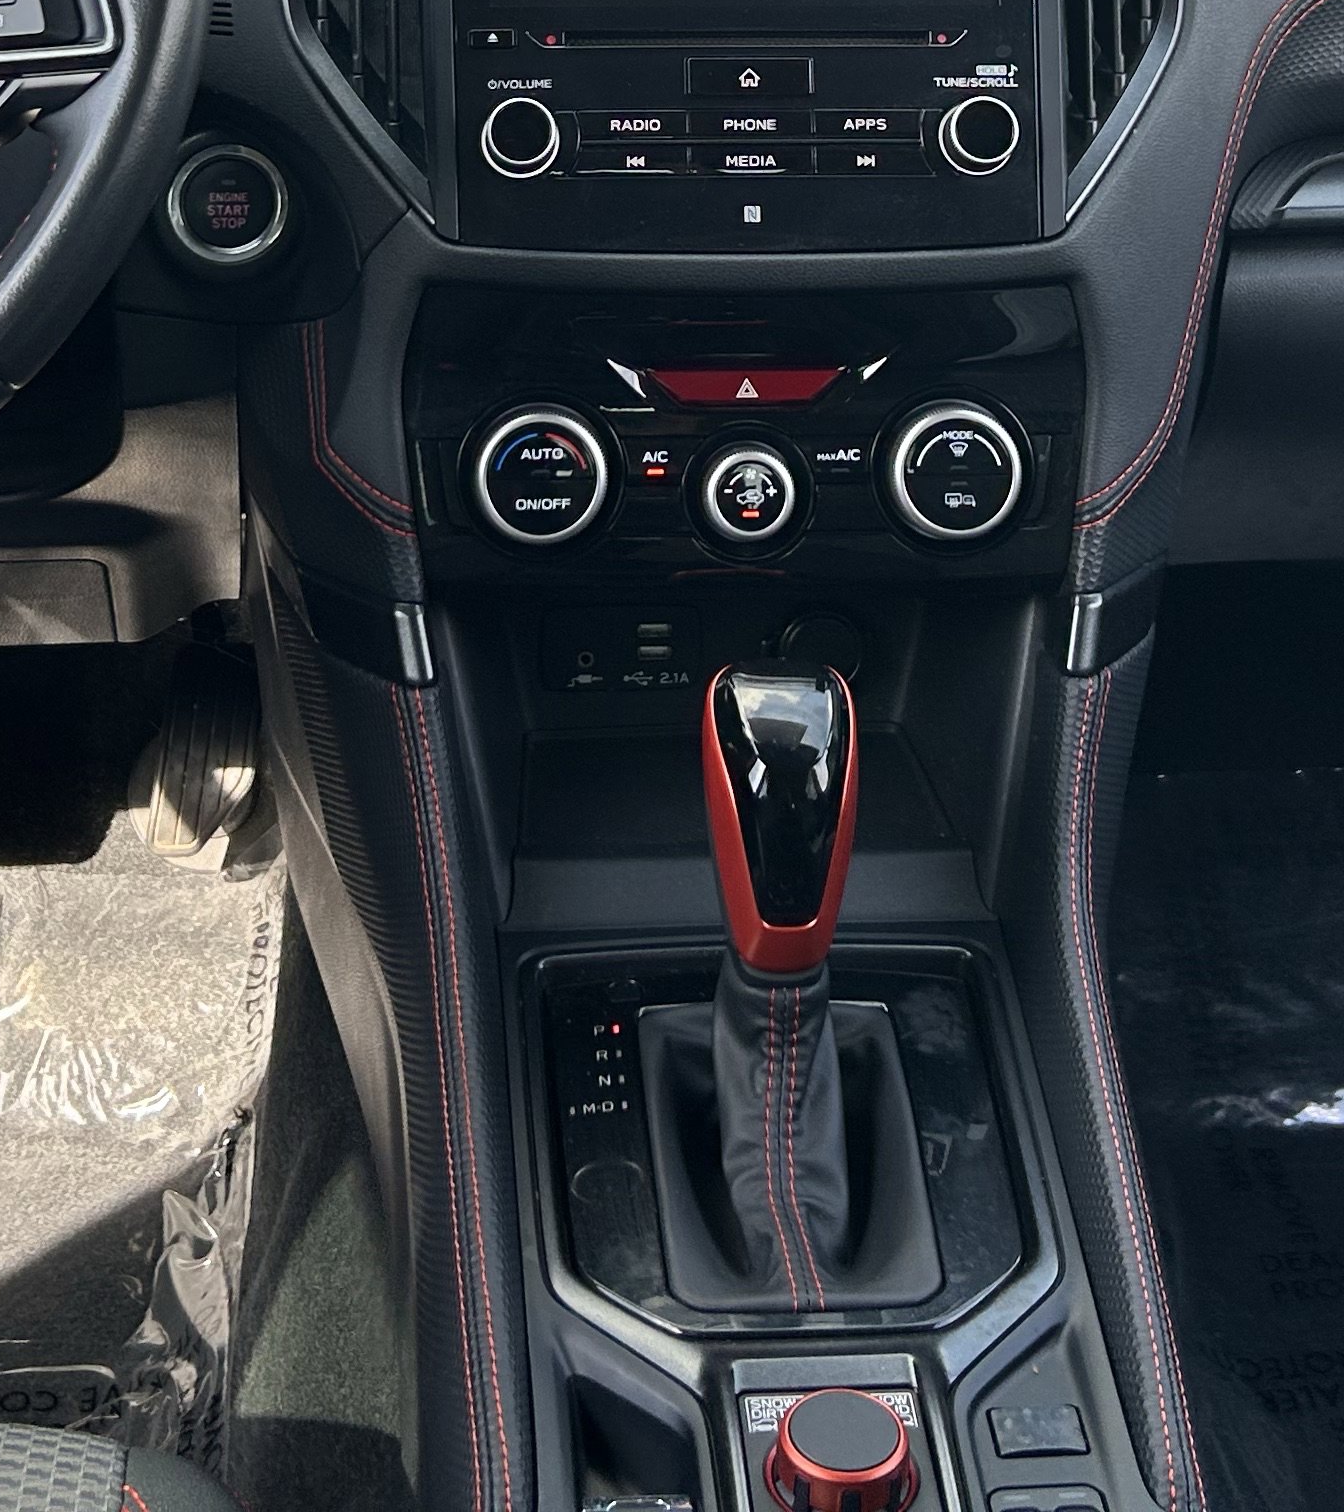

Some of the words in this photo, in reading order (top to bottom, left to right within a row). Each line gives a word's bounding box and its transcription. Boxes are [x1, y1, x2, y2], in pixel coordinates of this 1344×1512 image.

[933, 77, 1019, 89] TUNE/SCROLL
[609, 119, 662, 133] RADIO
[723, 119, 778, 132] PHONE
[843, 118, 888, 131] APPS
[725, 155, 777, 168] MEDIA
[209, 192, 249, 204] ENGINE
[206, 204, 250, 217] START
[211, 217, 248, 230] STOP
[942, 429, 975, 441] MODE
[520, 447, 565, 461] AUTO
[642, 450, 669, 464] A/C
[515, 497, 572, 512] ON/OFF
[659, 670, 690, 685] 2.1A
[593, 1023, 605, 1037] P
[596, 1048, 609, 1062] R
[599, 1073, 612, 1087] N
[749, 1398, 798, 1409] SNOW
[750, 1408, 787, 1420] DIRT
